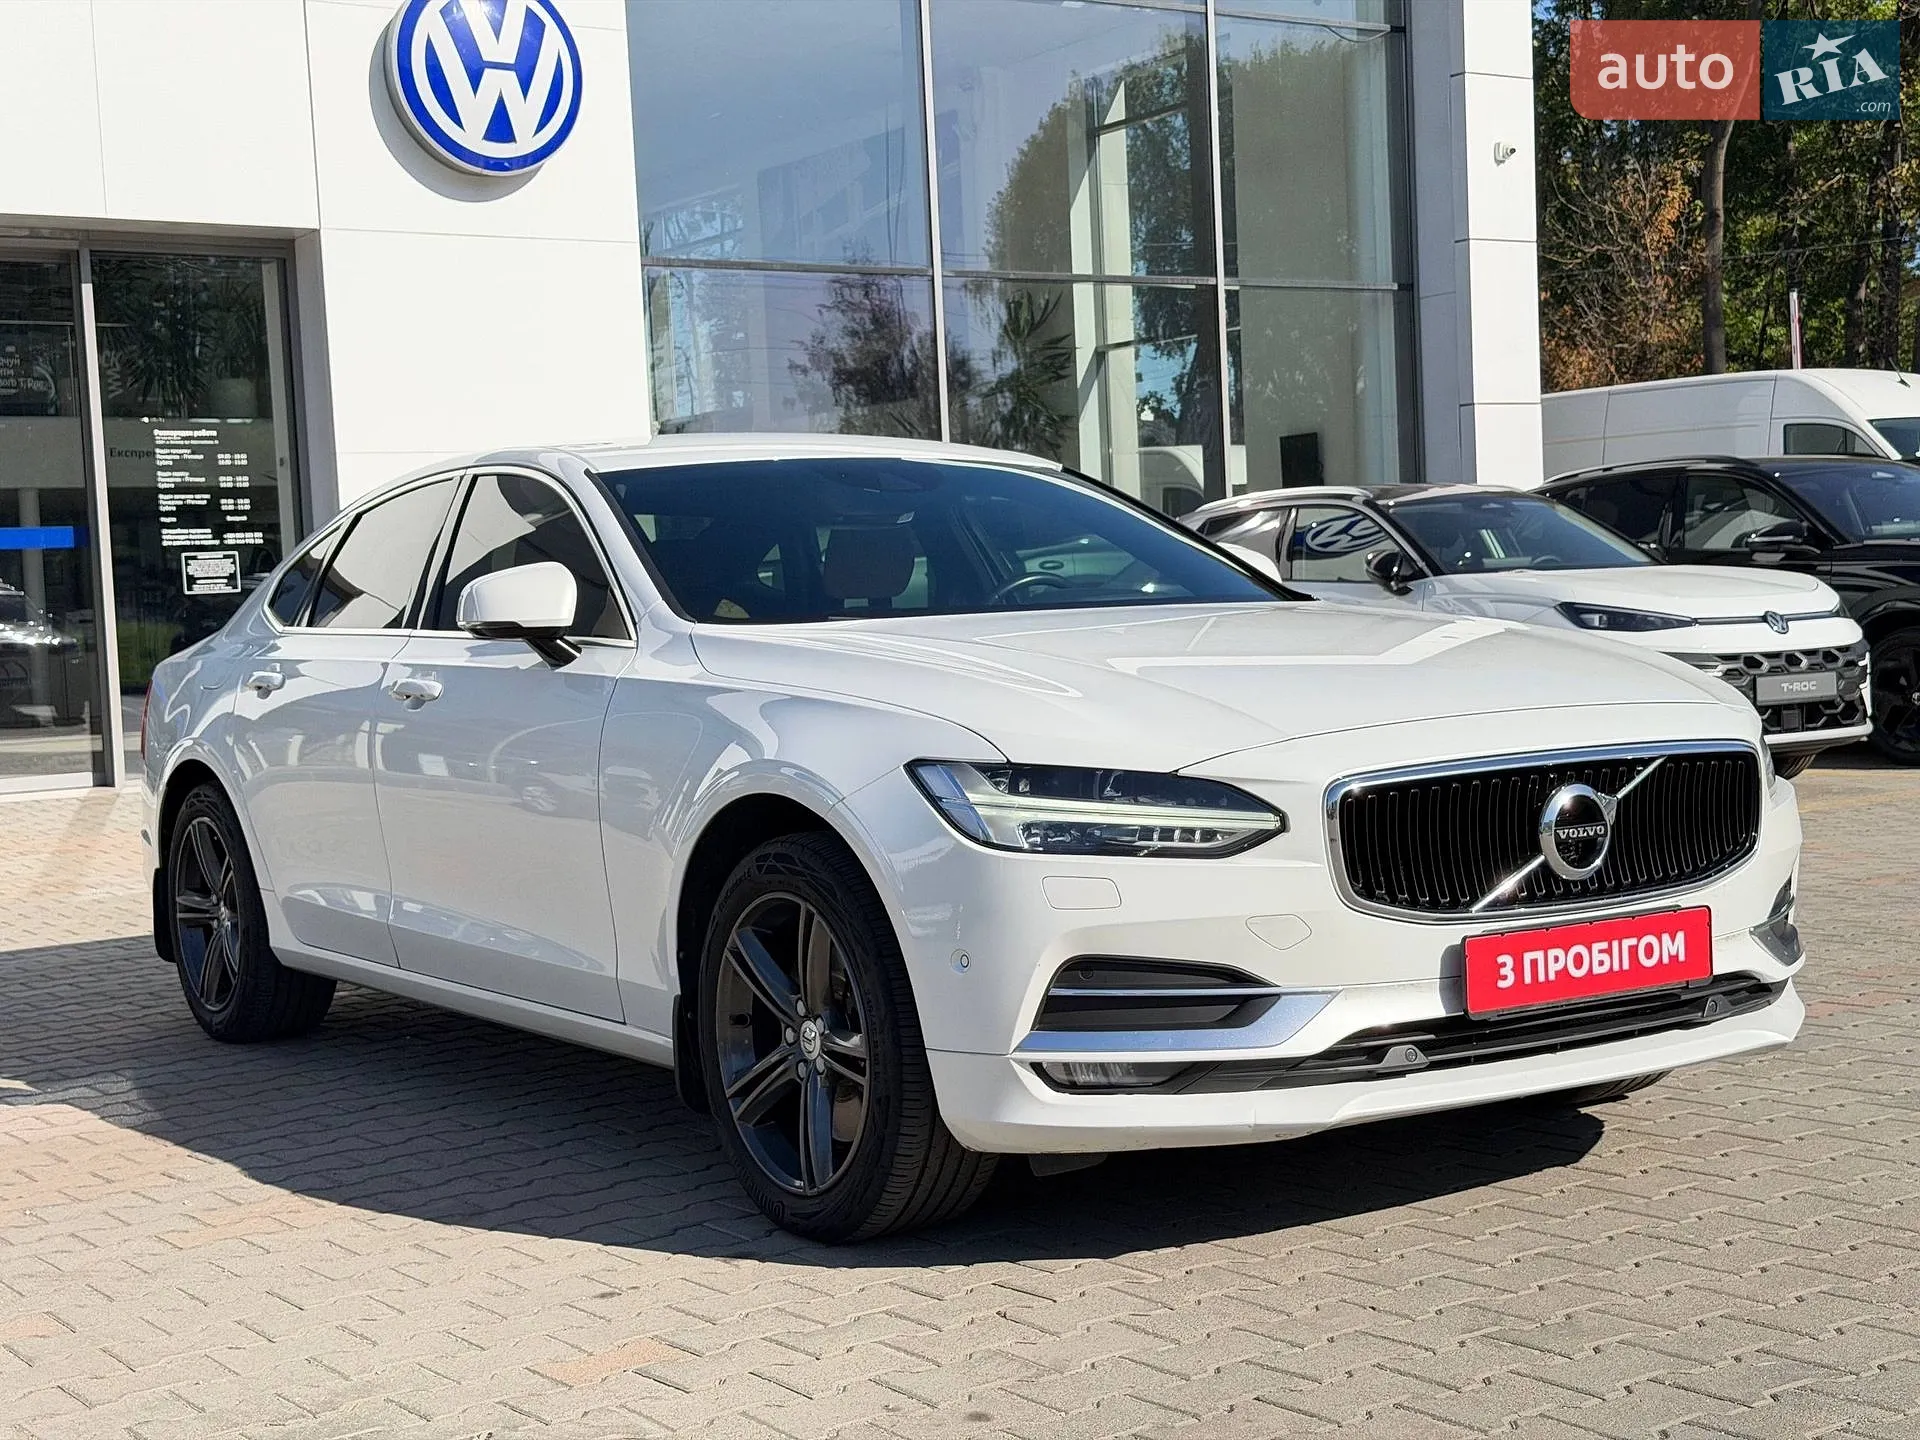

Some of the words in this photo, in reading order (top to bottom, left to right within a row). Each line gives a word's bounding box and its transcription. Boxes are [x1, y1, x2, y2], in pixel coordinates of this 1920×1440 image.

[109, 447, 156, 463] Експре
[1781, 680, 1817, 693] T-ROC
[1556, 824, 1606, 840] VOLVO
[1523, 930, 1687, 986] ПРОБІГОМ
